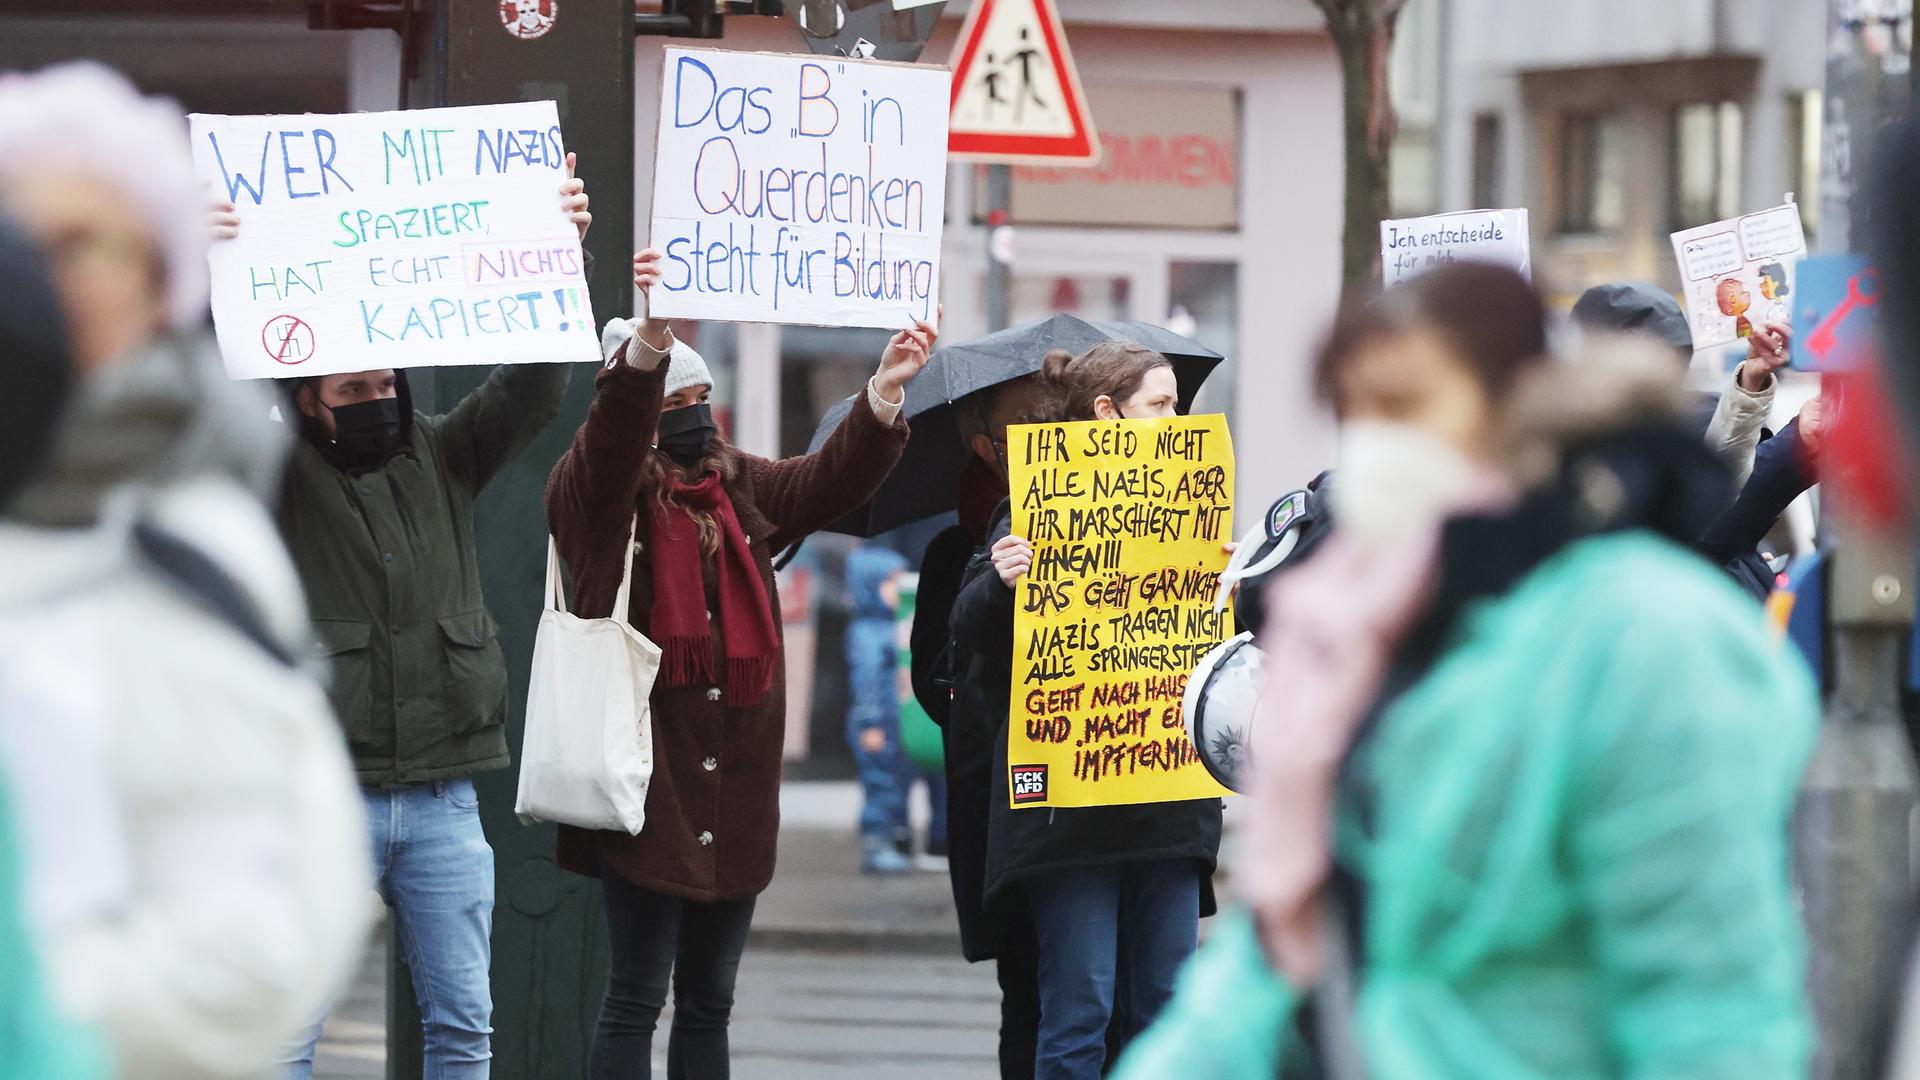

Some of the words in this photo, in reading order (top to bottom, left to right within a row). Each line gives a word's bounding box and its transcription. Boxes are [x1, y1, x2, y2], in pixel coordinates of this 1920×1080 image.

[674, 56, 773, 134] Das
[862, 90, 904, 145] in
[208, 128, 354, 205] WER
[383, 128, 455, 186] MIT
[475, 125, 562, 176] NAZIS
[694, 136, 924, 233] Querdenken
[332, 200, 490, 248] SPAZIERT,
[1421, 220, 1504, 246] entscheide
[250, 260, 332, 302] HAT
[369, 255, 450, 287] ECHT
[475, 247, 582, 283] NICHTS
[770, 226, 827, 311] für
[834, 231, 933, 323] Bildung
[1393, 252, 1418, 277] für
[1025, 427, 1071, 465] IHR
[1022, 468, 1085, 510] ALLE
[1173, 465, 1228, 505] ABER
[1192, 503, 1231, 542] MIT
[1023, 579, 1075, 617] DAS
[1108, 604, 1180, 644] TRAGEN
[1024, 654, 1076, 686] ALLE
[1025, 682, 1085, 716] GEHT
[1090, 681, 1141, 709] NACH
[1145, 672, 1188, 701] HAUS
[1026, 715, 1072, 744] UND
[1084, 708, 1152, 744] MACHT
[1014, 772, 1043, 784] FCK
[1015, 782, 1043, 795] AFD
